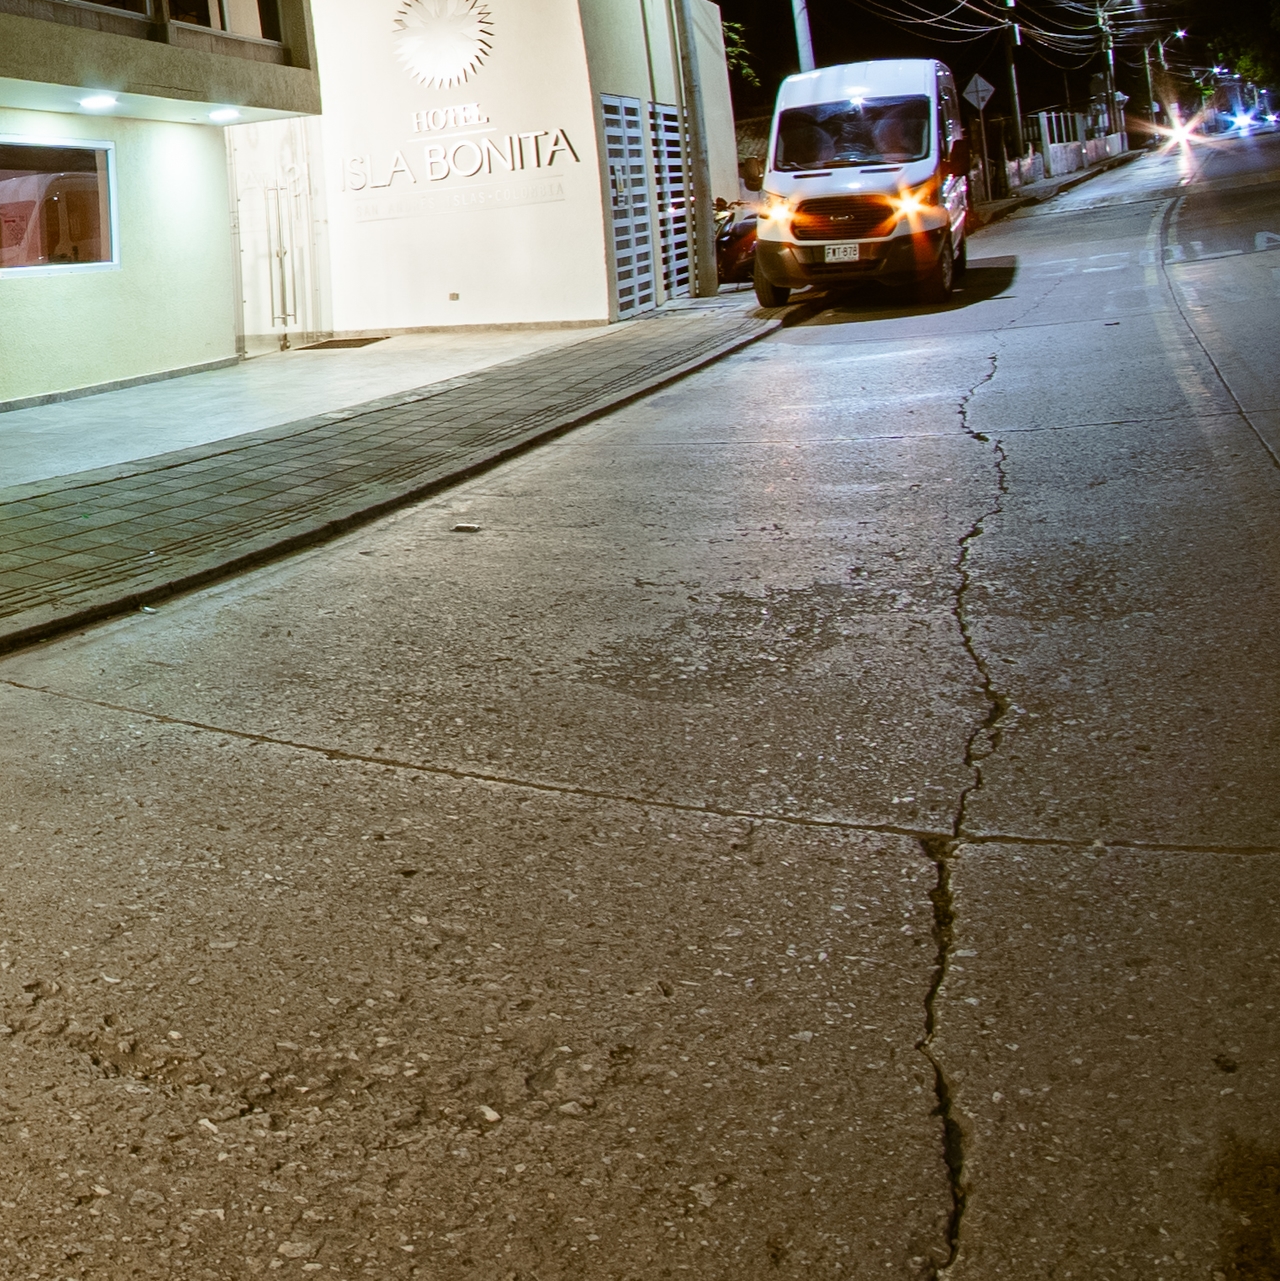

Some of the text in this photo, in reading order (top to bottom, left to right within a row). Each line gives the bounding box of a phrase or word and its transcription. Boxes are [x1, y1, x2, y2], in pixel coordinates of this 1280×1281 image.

[411, 102, 490, 134] HOTEL
[342, 150, 416, 192] ISLA
[426, 128, 580, 182] BONITA
[447, 190, 487, 207] ISLAS
[495, 181, 565, 202] COLOMBIA
